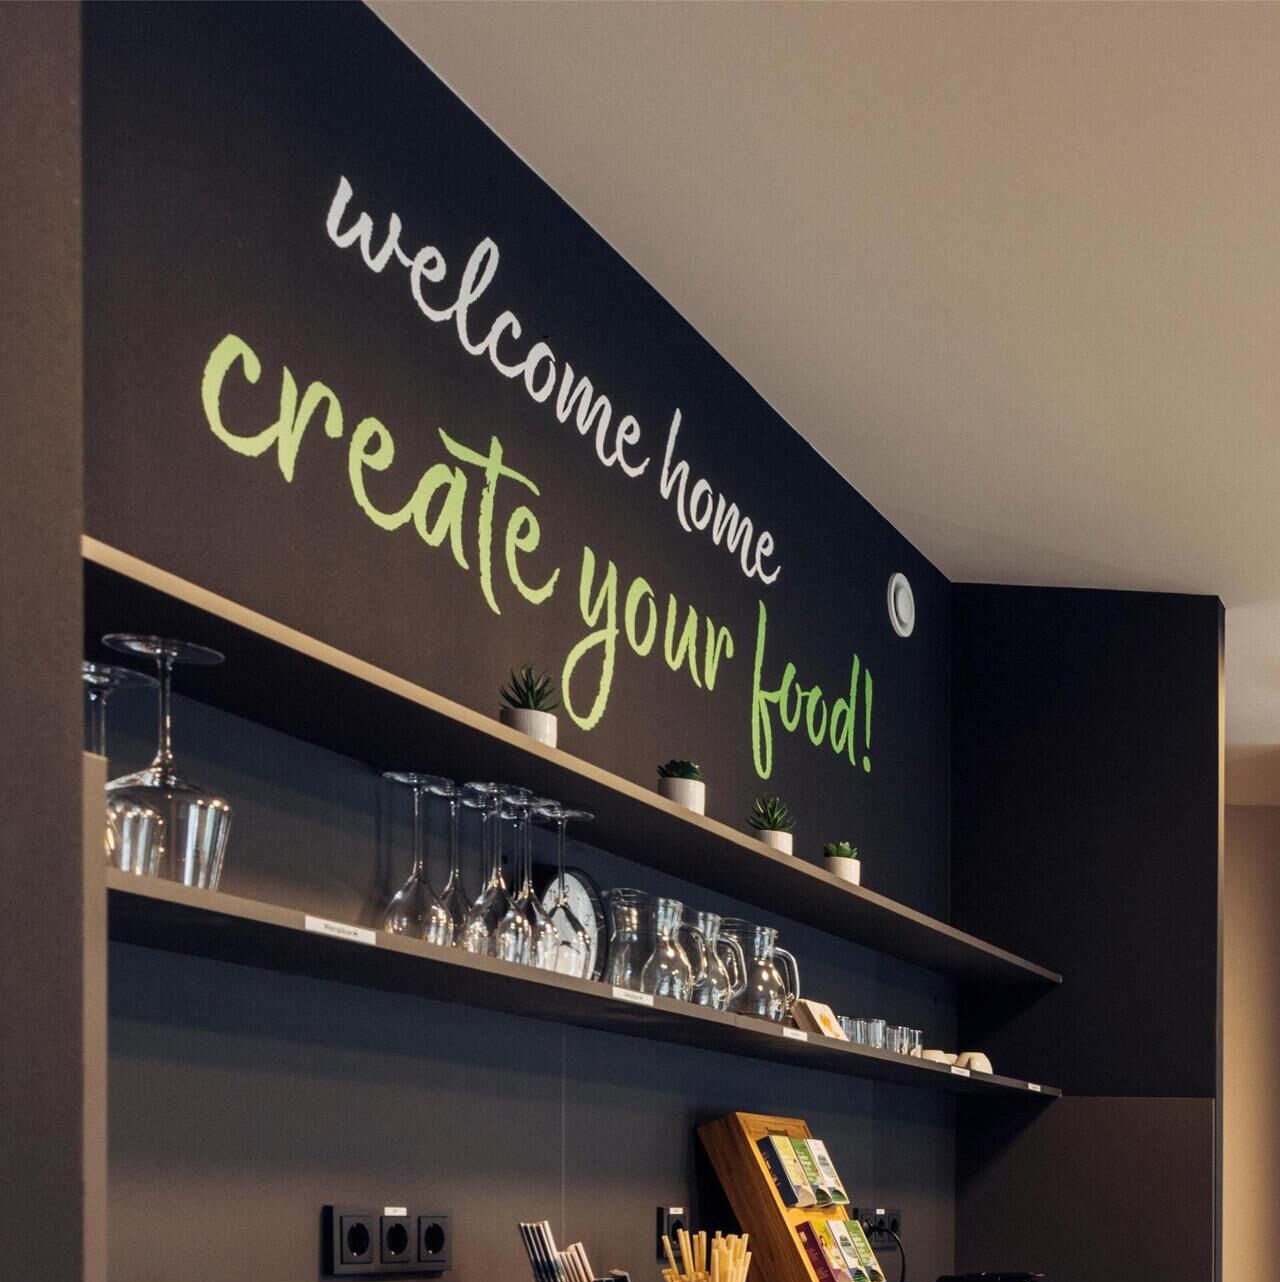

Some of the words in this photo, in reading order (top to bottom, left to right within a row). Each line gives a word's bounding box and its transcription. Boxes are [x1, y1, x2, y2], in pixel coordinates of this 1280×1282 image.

[201, 334, 560, 615] create
[561, 546, 734, 731] your
[752, 600, 872, 779] food!
[326, 176, 650, 477] welcome
[660, 408, 781, 584] home
